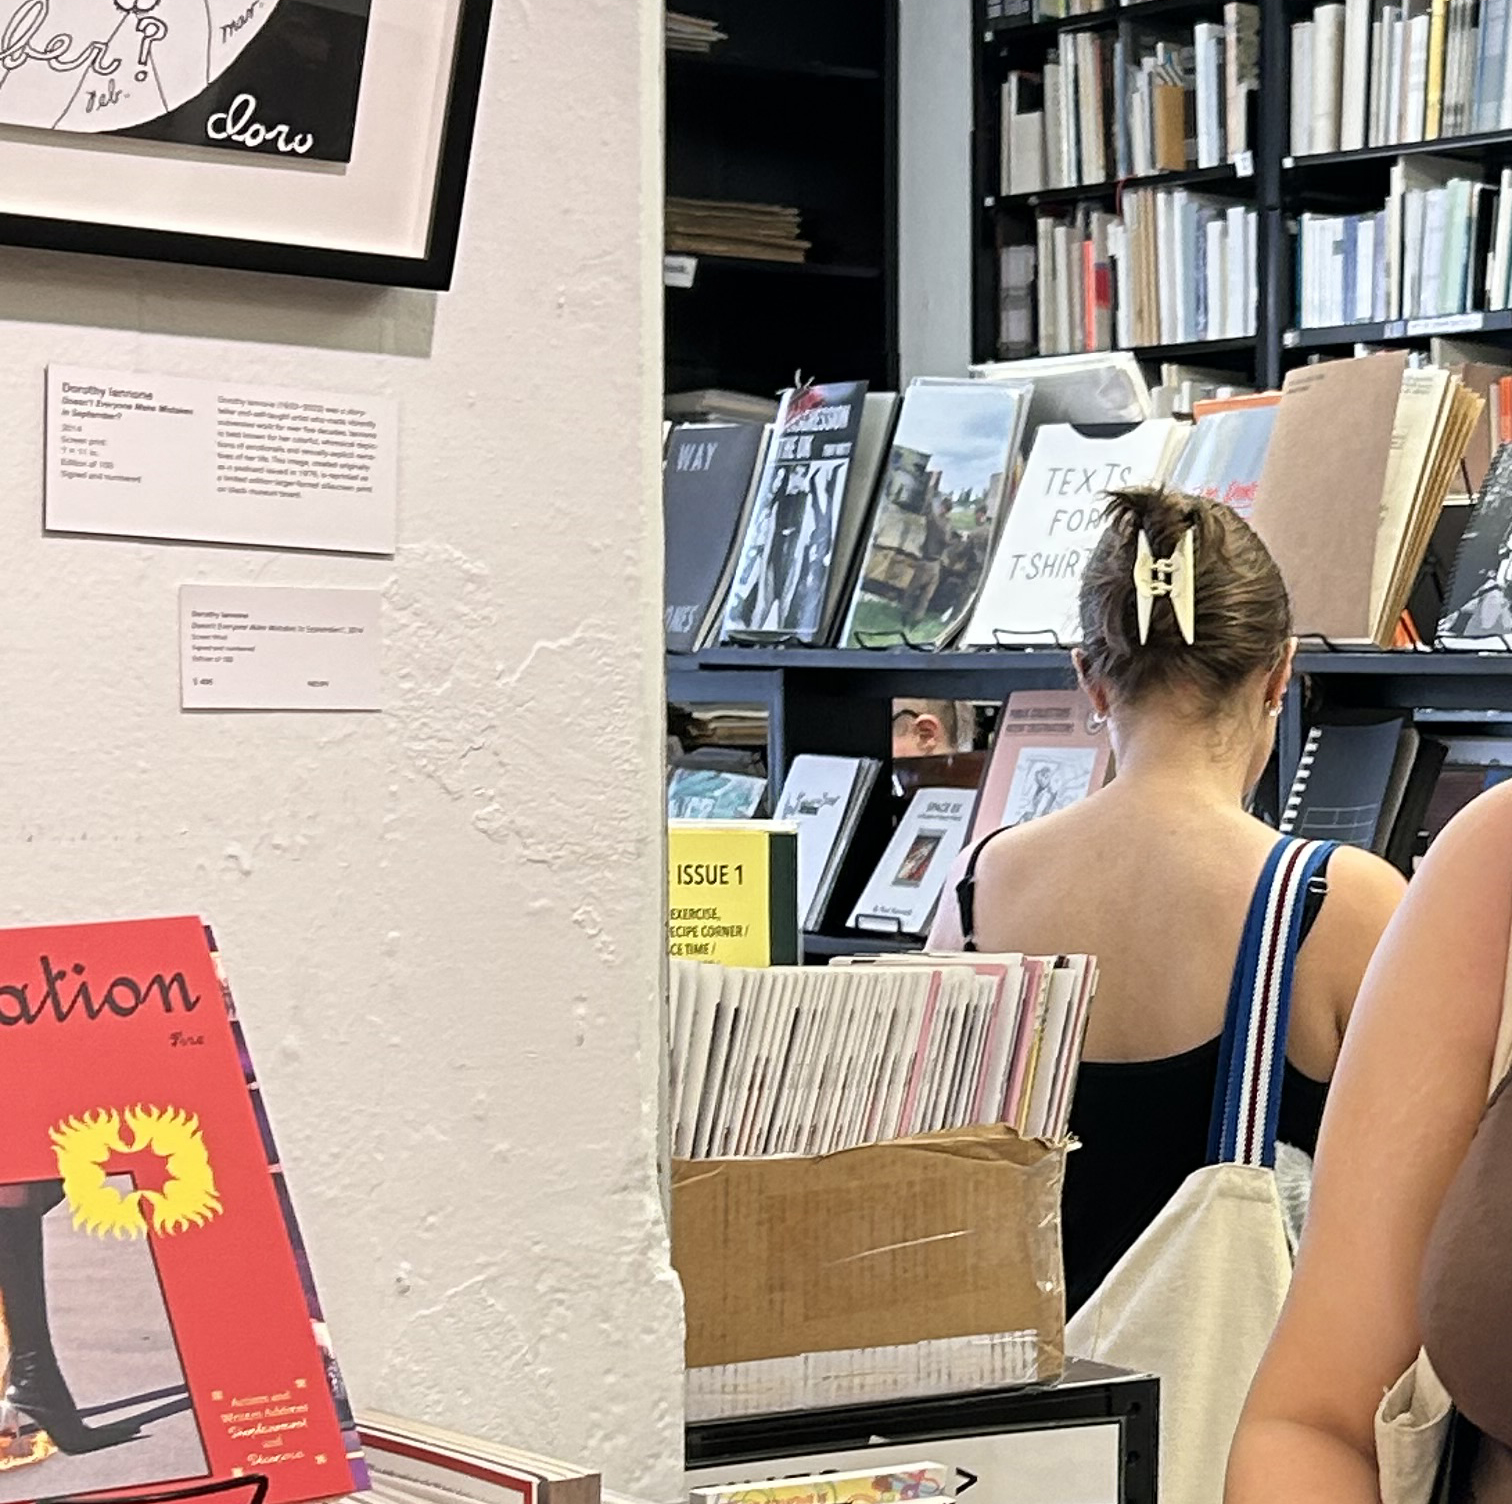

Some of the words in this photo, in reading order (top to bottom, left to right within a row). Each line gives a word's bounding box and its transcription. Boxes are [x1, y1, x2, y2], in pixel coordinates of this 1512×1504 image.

[676, 441, 719, 472] WAY
[1045, 463, 1132, 496] TEXTS
[677, 864, 729, 885] ISSUE
[734, 864, 743, 885] 1
[670, 907, 721, 921] EXERCISE,
[669, 925, 699, 938] ECIPE
[701, 925, 743, 938] CORNER
